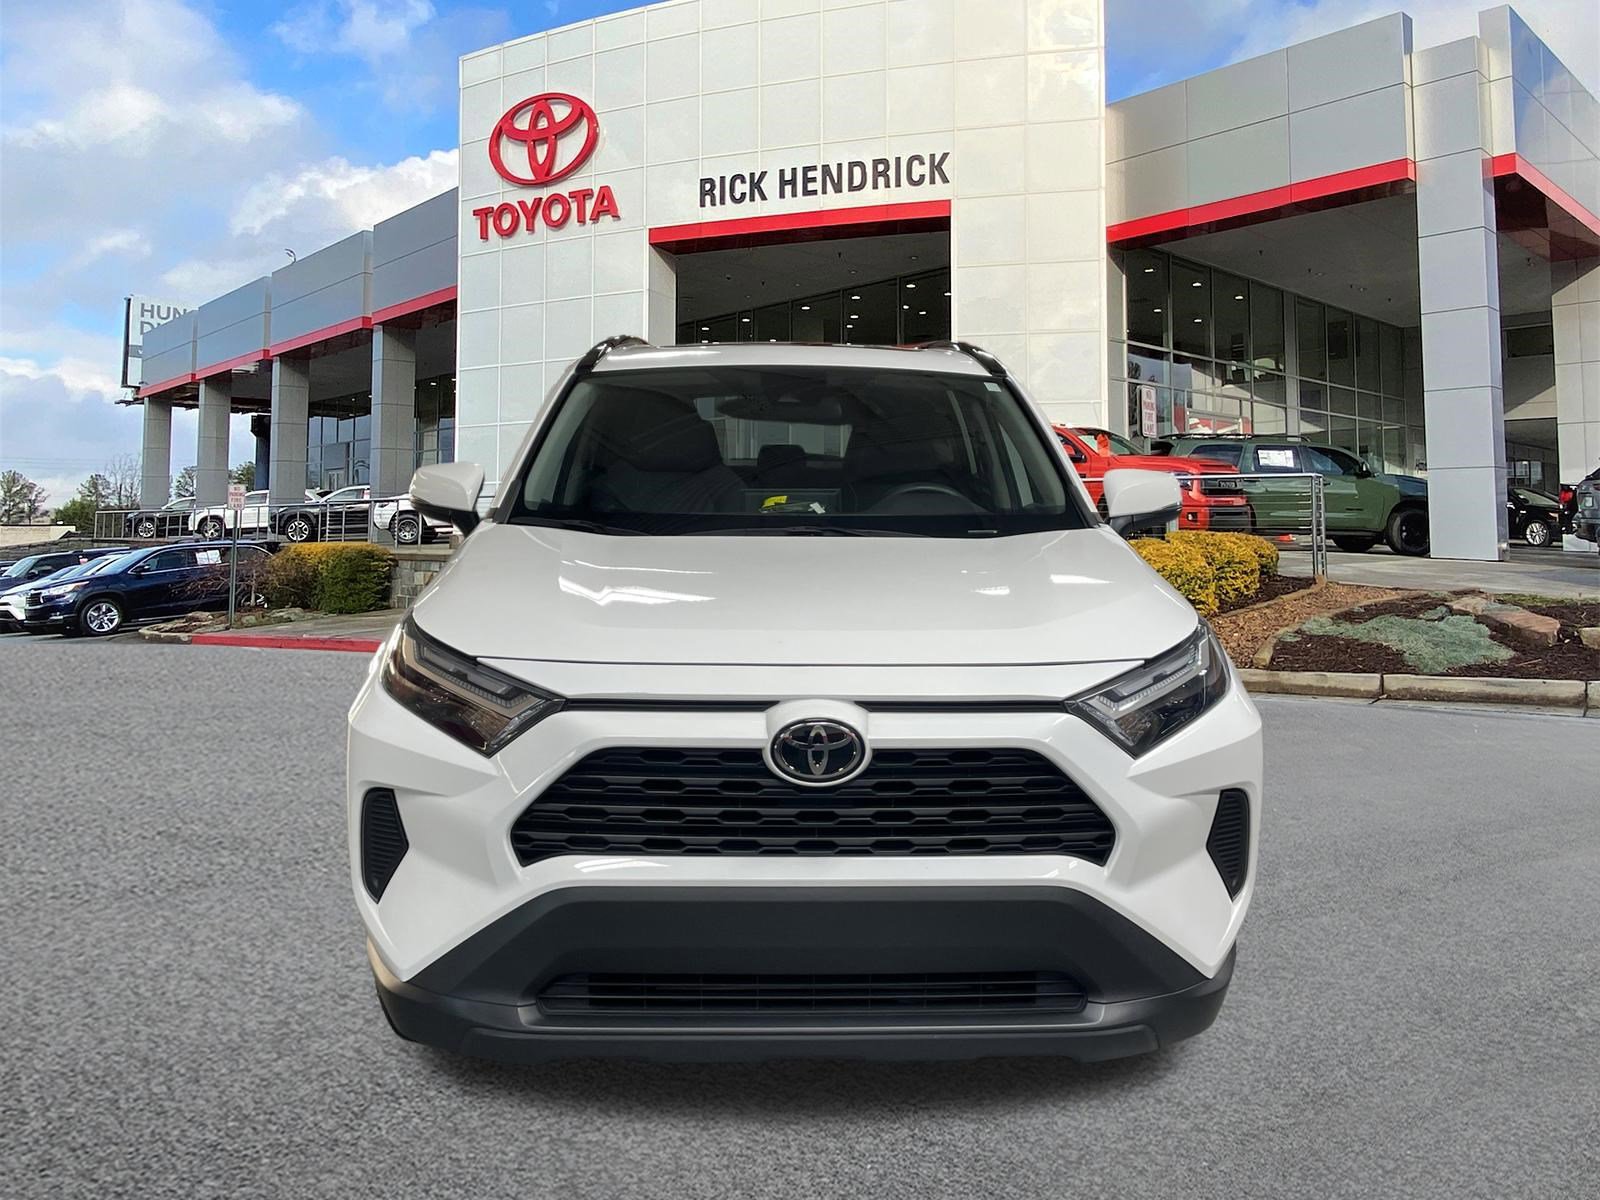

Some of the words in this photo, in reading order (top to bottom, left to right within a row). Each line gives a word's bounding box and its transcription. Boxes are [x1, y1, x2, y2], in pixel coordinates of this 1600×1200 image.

[699, 170, 768, 208] RICK
[779, 152, 950, 199] HENDRICK
[473, 185, 621, 241] TOYOTA
